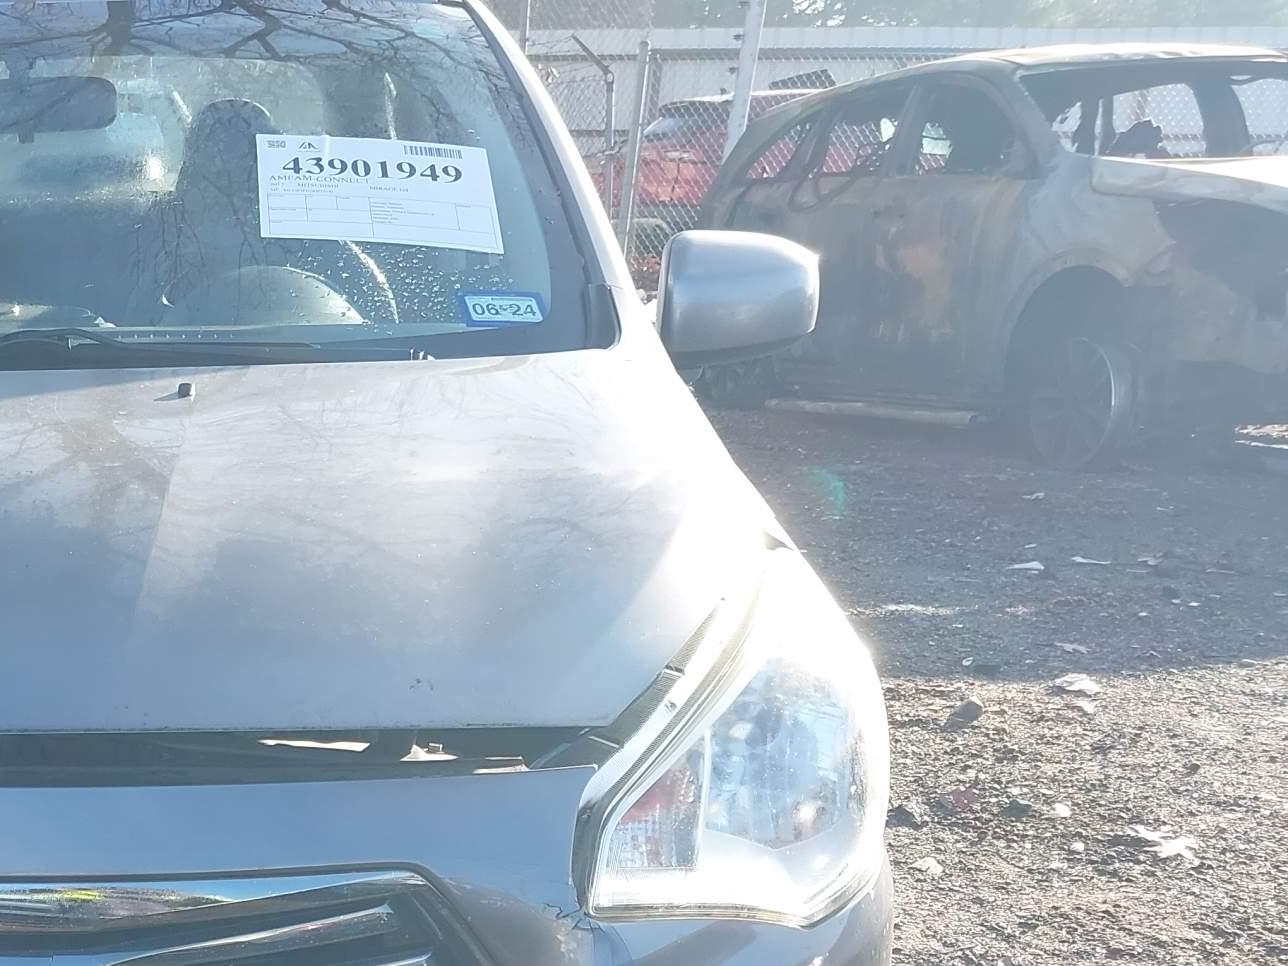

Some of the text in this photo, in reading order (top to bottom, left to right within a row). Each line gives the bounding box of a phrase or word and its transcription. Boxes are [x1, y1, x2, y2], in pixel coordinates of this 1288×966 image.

[282, 156, 463, 184] 43901949
[472, 302, 537, 317] 06 24
